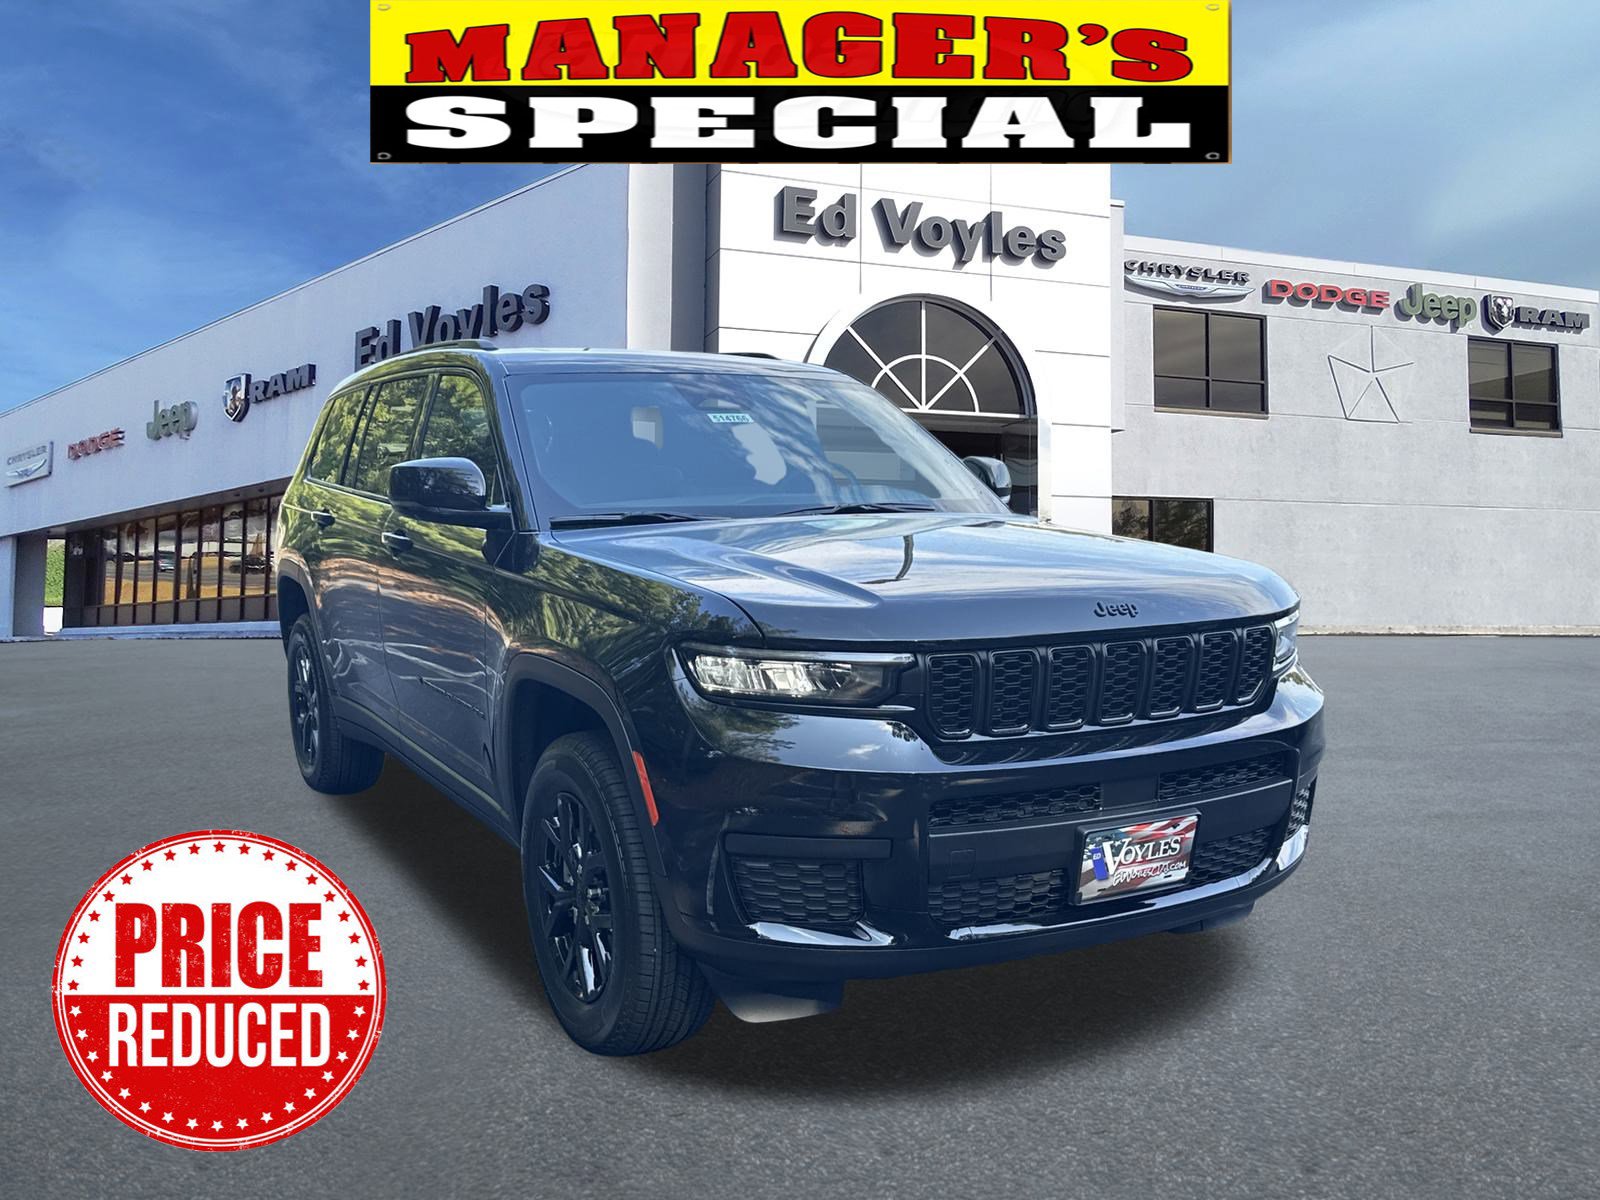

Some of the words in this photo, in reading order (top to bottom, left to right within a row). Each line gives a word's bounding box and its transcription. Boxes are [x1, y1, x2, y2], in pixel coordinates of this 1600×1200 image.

[774, 185, 857, 247] Ed
[871, 197, 1067, 270] Voyles
[1124, 259, 1250, 287] CHRYSLER
[1262, 279, 1391, 316] DODGE
[1393, 283, 1477, 333] Jeep
[354, 319, 401, 373] Ed
[408, 284, 550, 349] Voyles
[1512, 305, 1591, 335] RAM
[250, 363, 316, 404] RAM
[146, 400, 199, 441] Jeep
[7, 445, 47, 466] CHRYSLER
[67, 427, 125, 461] DODGE
[1093, 601, 1139, 618] Jeep
[1102, 835, 1183, 876] VOYLES
